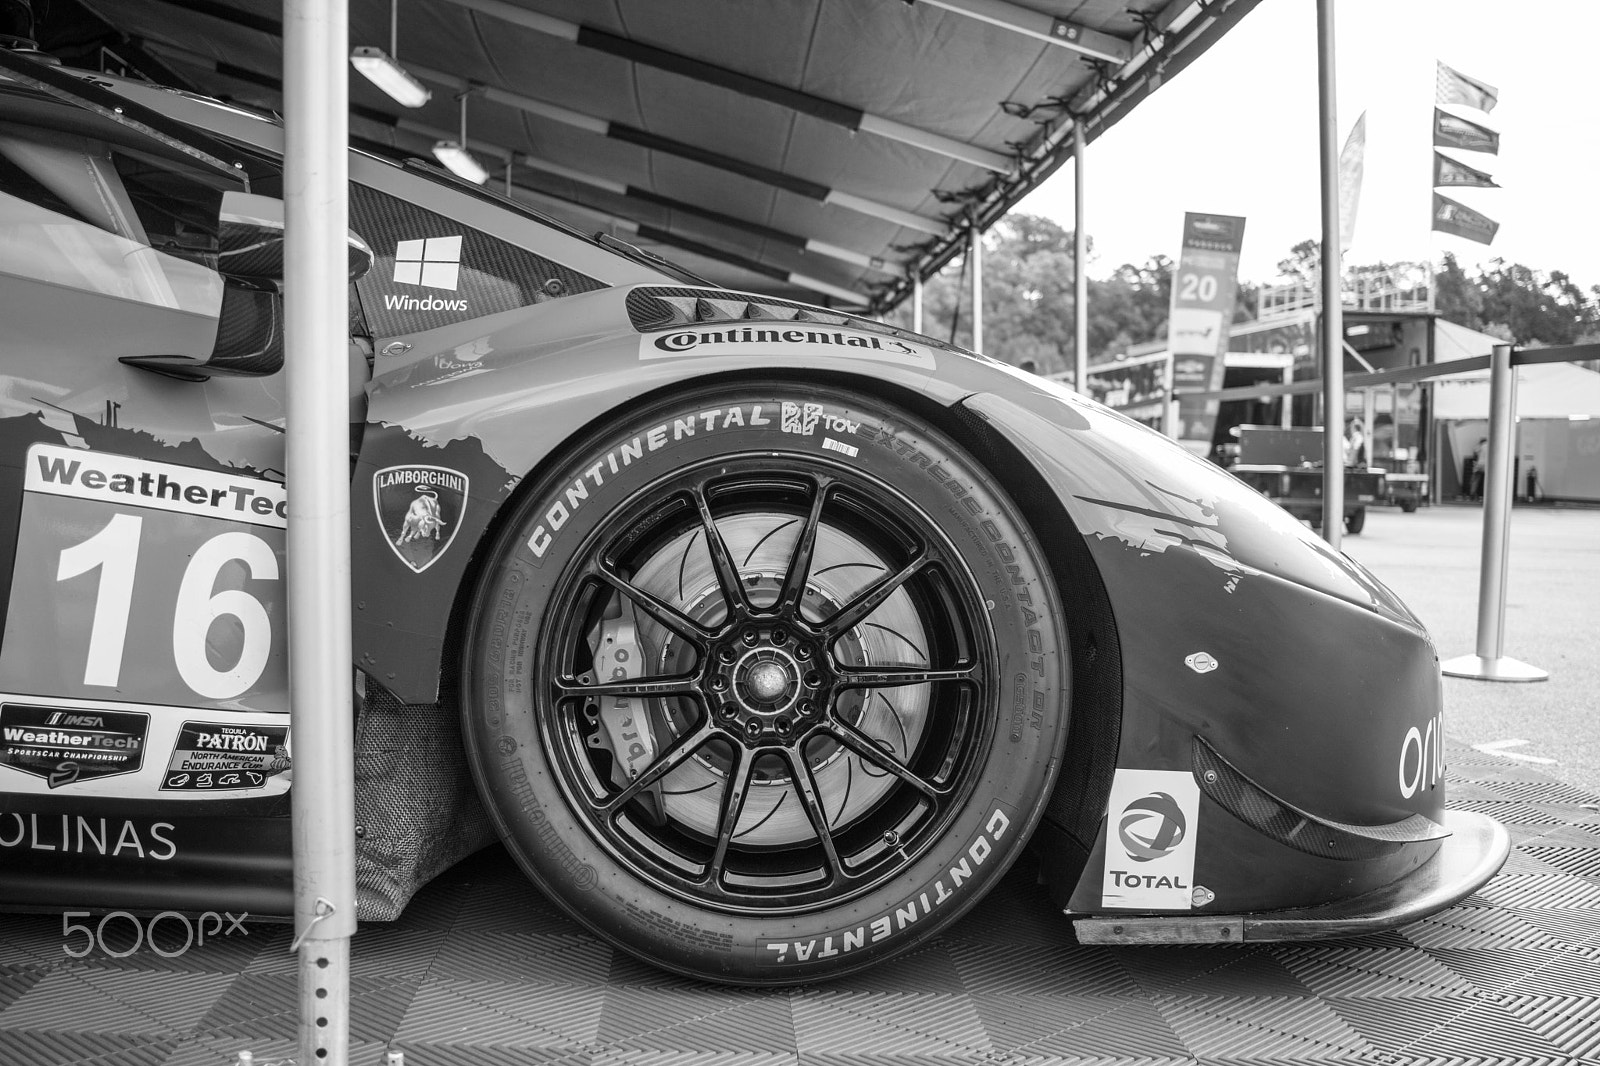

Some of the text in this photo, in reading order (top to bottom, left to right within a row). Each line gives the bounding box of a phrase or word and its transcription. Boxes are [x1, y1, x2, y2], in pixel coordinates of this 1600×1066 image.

[1180, 273, 1218, 302] 20
[384, 294, 468, 312] Windows
[654, 328, 885, 352] Continental
[37, 455, 287, 519] WeatherTec
[380, 470, 462, 491] LAMBORGHINI
[527, 404, 771, 558] CONTINENTAL
[56, 513, 279, 699] 16
[63, 714, 105, 728] IMSA
[221, 727, 247, 735] TEQUILA
[3, 727, 140, 749] WeatherTech
[196, 732, 269, 752] PATRÓN
[63, 751, 128, 762] CHAMPIONSHIP
[181, 760, 241, 770] ENDURANCE
[190, 751, 265, 763] NORTH AMERICAN
[500, 757, 599, 892] Continental
[0, 812, 177, 861] OLINAS
[766, 808, 1010, 963] CONTINENTAL
[1109, 870, 1188, 889] TOTAL
